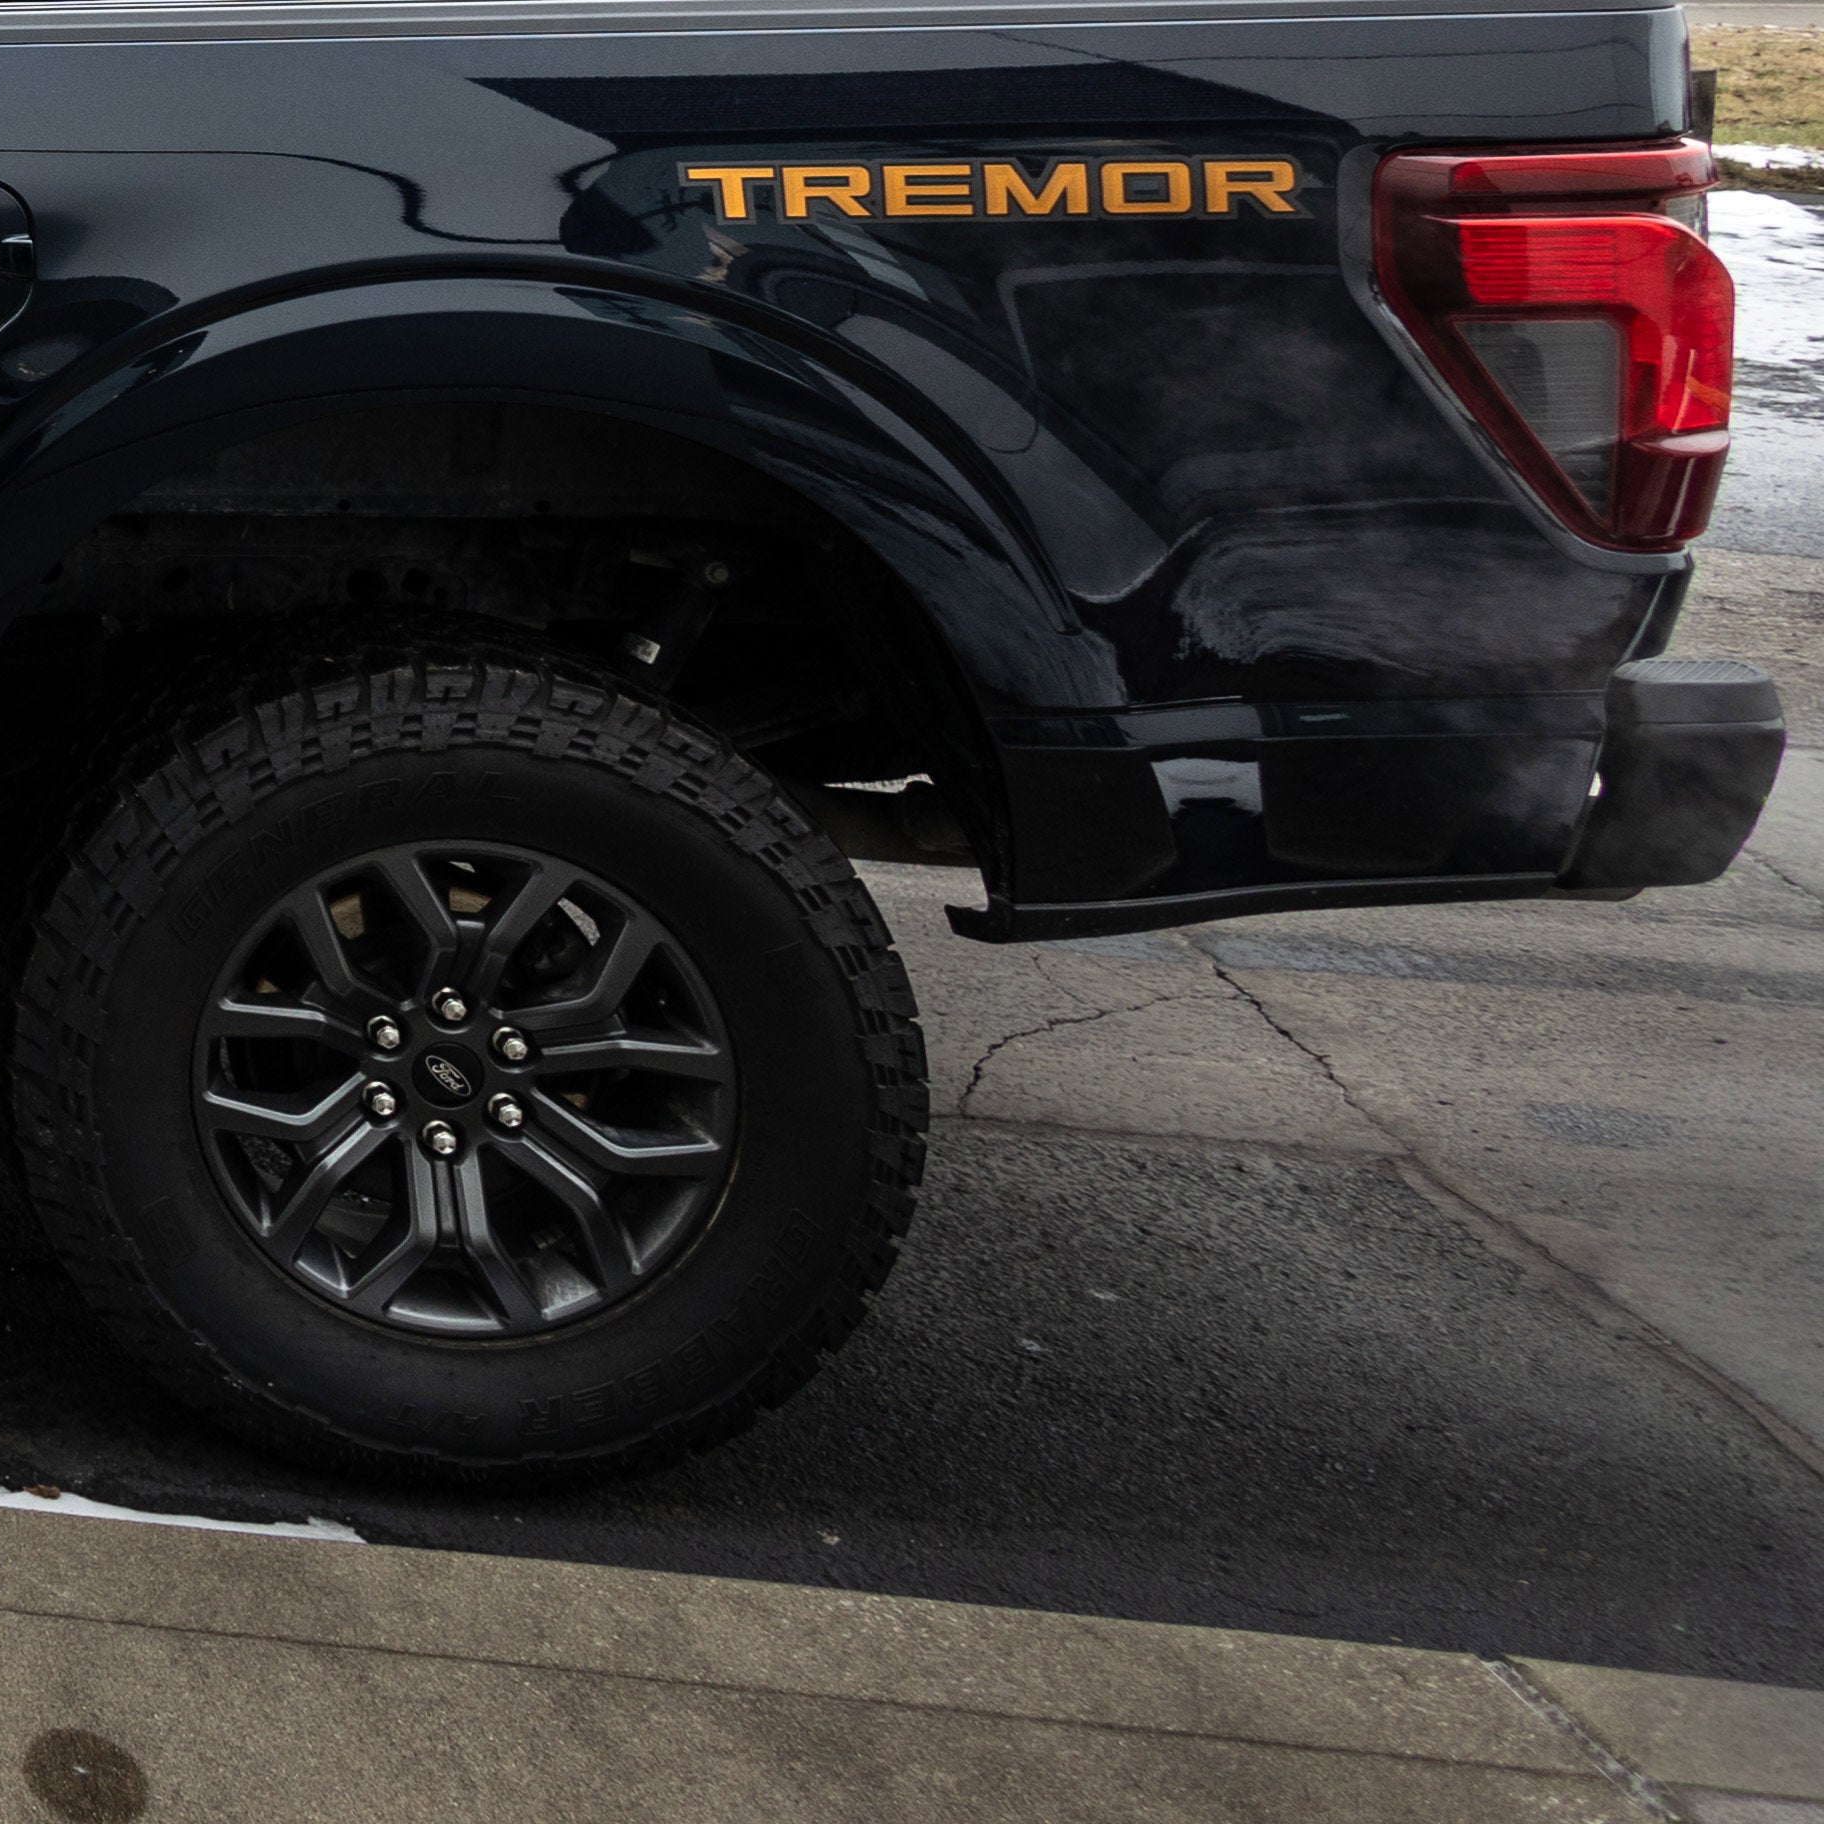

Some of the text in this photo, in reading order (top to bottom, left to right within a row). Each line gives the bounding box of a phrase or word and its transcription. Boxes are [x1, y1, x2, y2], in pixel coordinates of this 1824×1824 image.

[684, 158, 1300, 221] TREMOR
[169, 770, 521, 945] GENERAL
[432, 1062, 464, 1092] Ford
[516, 1206, 824, 1438] GRABBER
